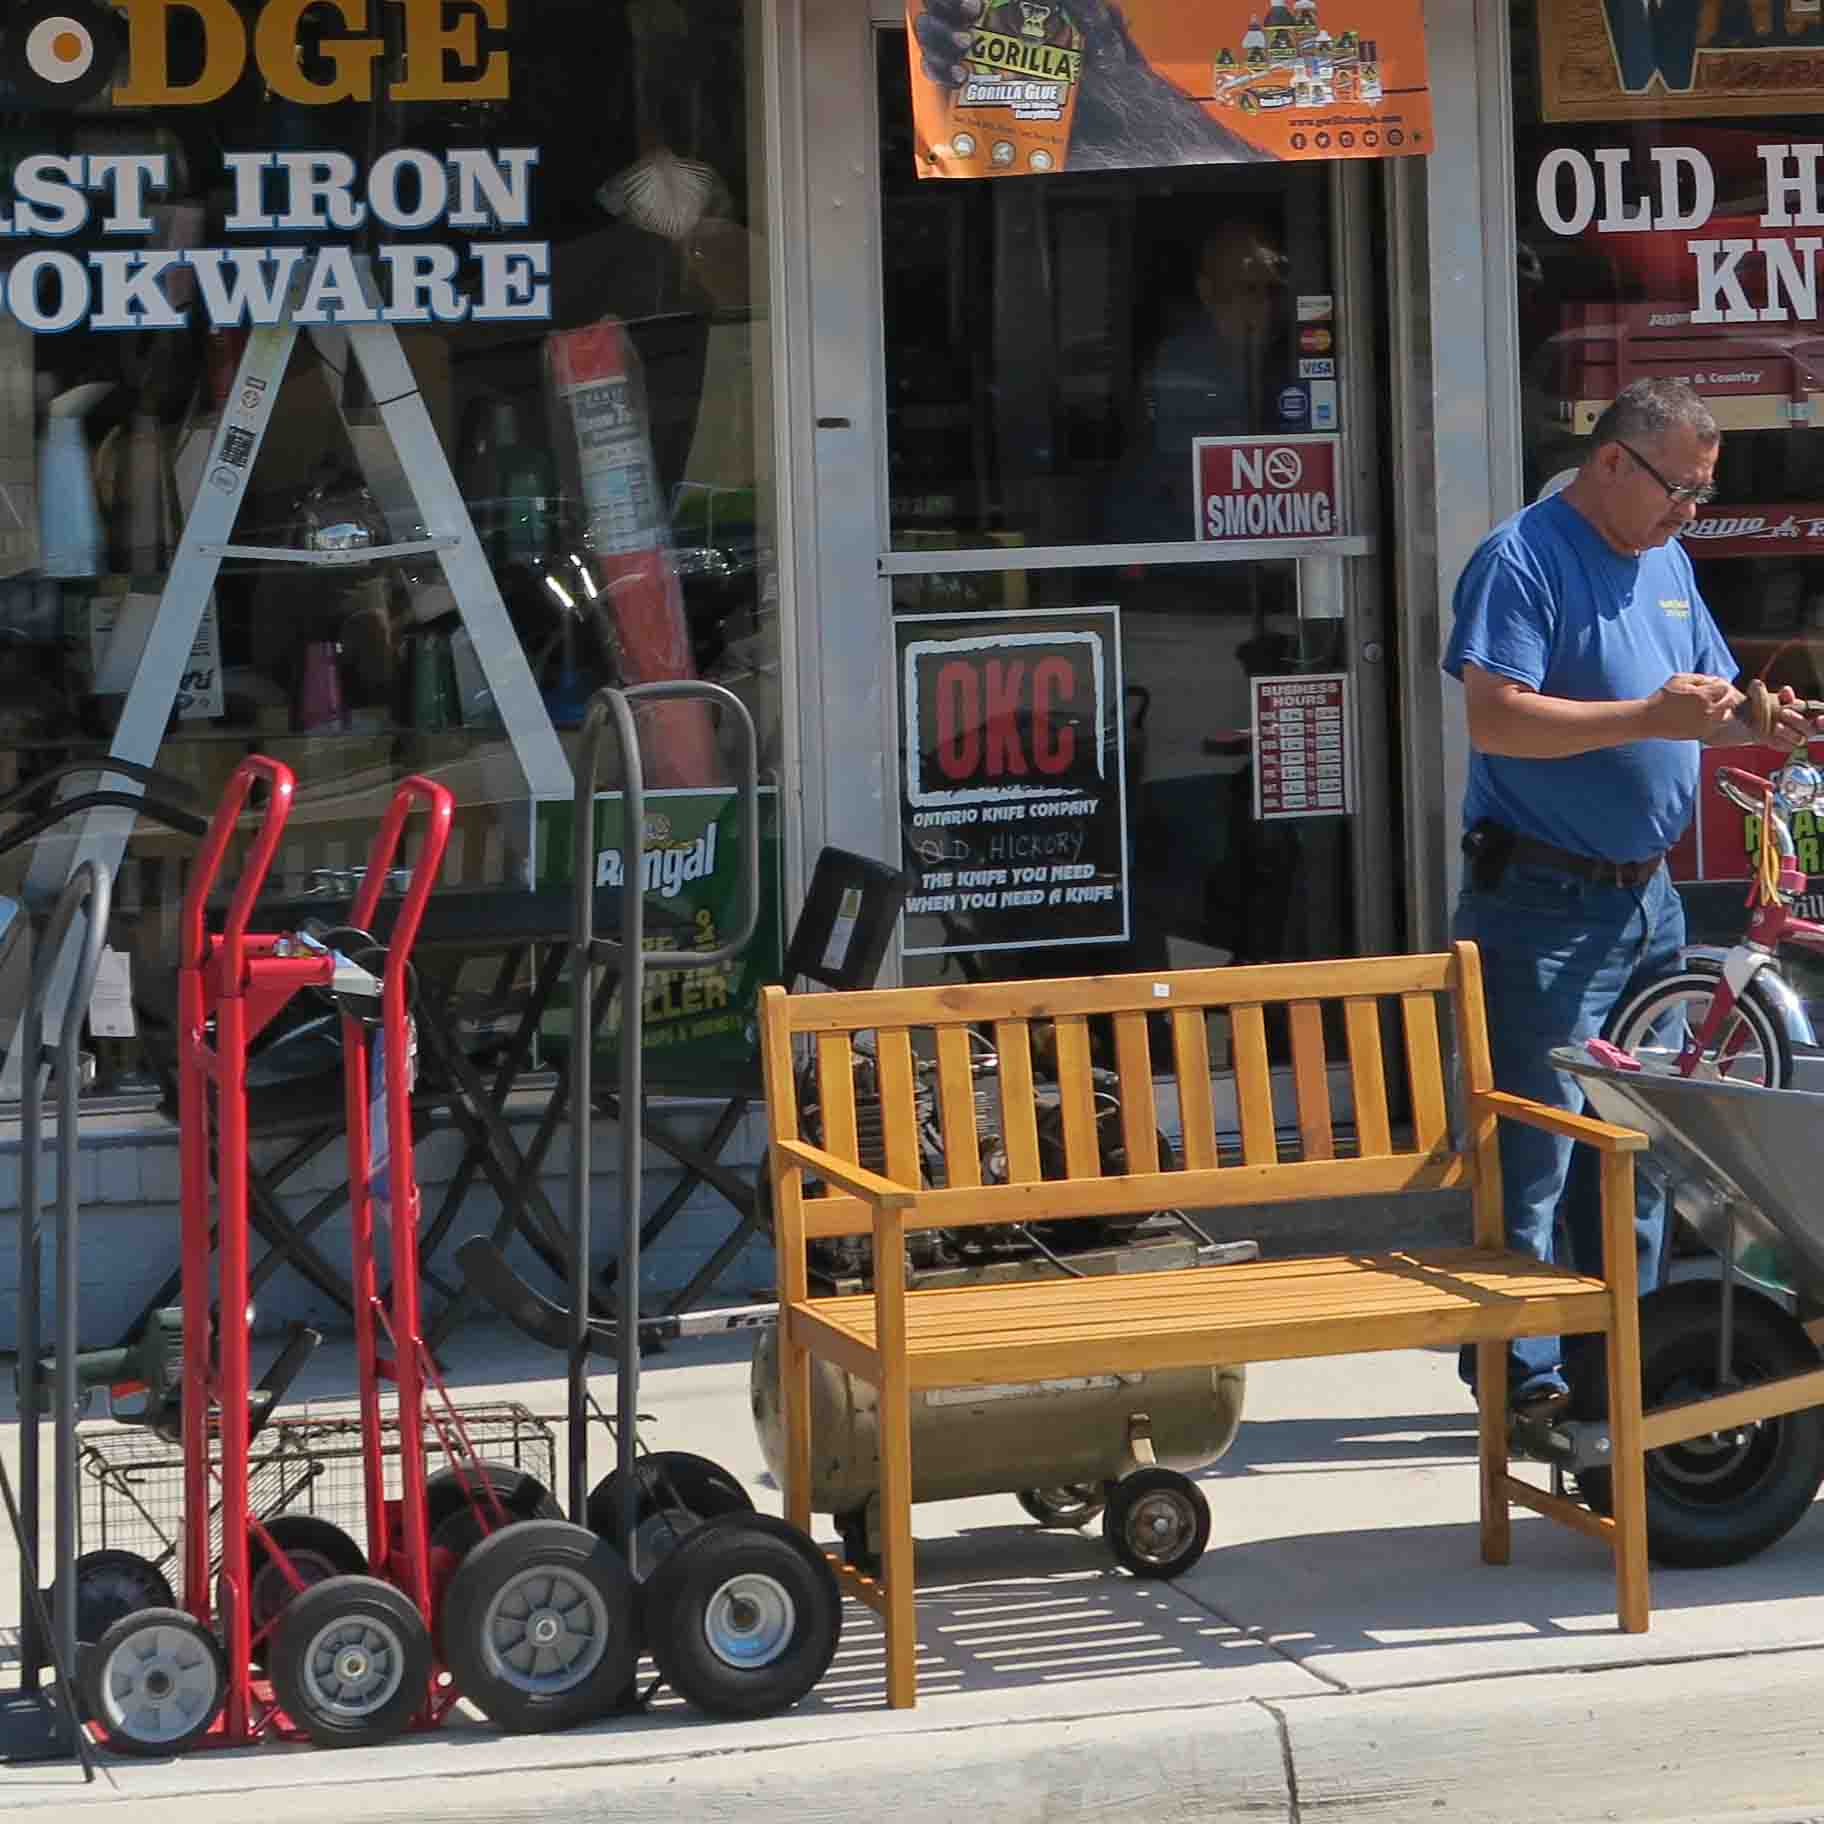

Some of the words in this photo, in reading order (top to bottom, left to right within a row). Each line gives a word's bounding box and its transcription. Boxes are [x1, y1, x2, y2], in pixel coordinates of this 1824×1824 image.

[974, 33, 1071, 79] GORILLA
[967, 84, 1022, 101] GORILLA
[1025, 82, 1058, 100] GLUE
[223, 148, 539, 230] IRON
[1537, 147, 1715, 235] OLD
[1300, 361, 1333, 376] VISA
[1231, 447, 1302, 490] NO
[1207, 492, 1332, 537] SMOKING
[1261, 682, 1340, 697] BUSINESS
[1272, 694, 1327, 707] HOURS
[934, 655, 1075, 780] OKC
[913, 808, 977, 826] ONTARIO
[982, 805, 1025, 822] KNIFE
[1029, 799, 1099, 818] COMPANY
[913, 839, 969, 864] OLD
[991, 831, 1085, 862] HICKORY
[922, 873, 953, 889] THE
[957, 869, 1007, 887] KNIFE
[1012, 866, 1047, 883] YOU
[1051, 864, 1096, 881] NEED
[906, 895, 955, 913] WHEN
[960, 892, 996, 910] YOU
[1000, 889, 1045, 908] NEED
[1049, 888, 1062, 905] A
[1065, 885, 1114, 902] KNIFE
